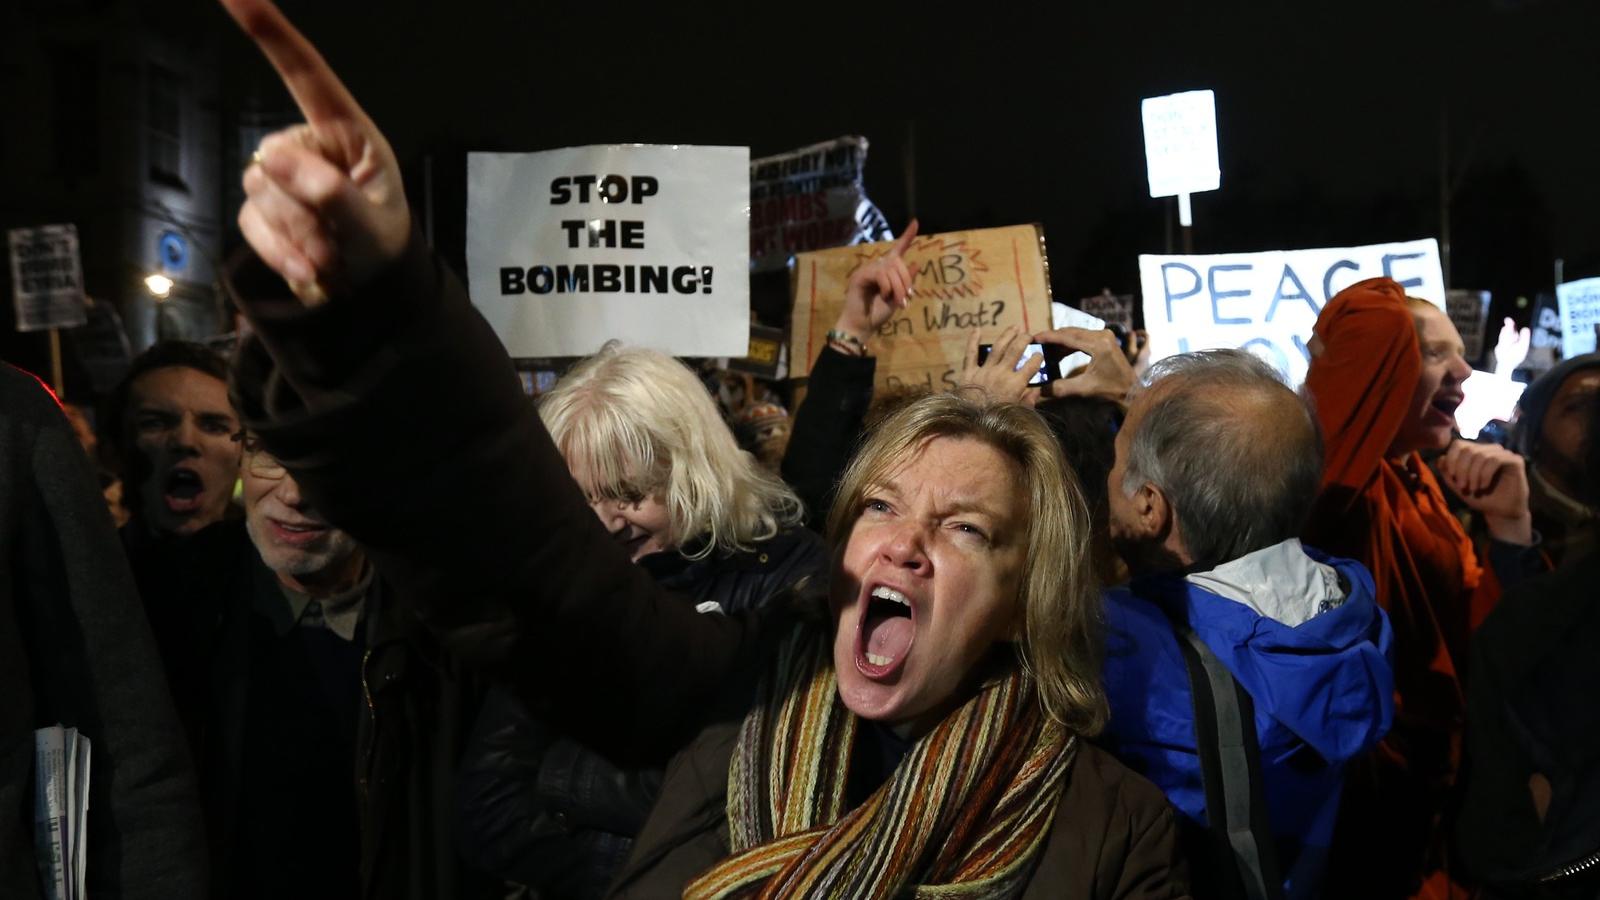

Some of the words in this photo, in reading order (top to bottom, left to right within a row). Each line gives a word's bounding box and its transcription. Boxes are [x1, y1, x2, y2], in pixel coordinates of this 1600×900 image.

[549, 174, 659, 206] STOP
[759, 191, 829, 231] BOMBS
[561, 219, 645, 250] THE
[499, 264, 714, 297] BOMBING!
[912, 254, 967, 286] MB
[876, 315, 914, 338] en
[924, 300, 1005, 335] What?
